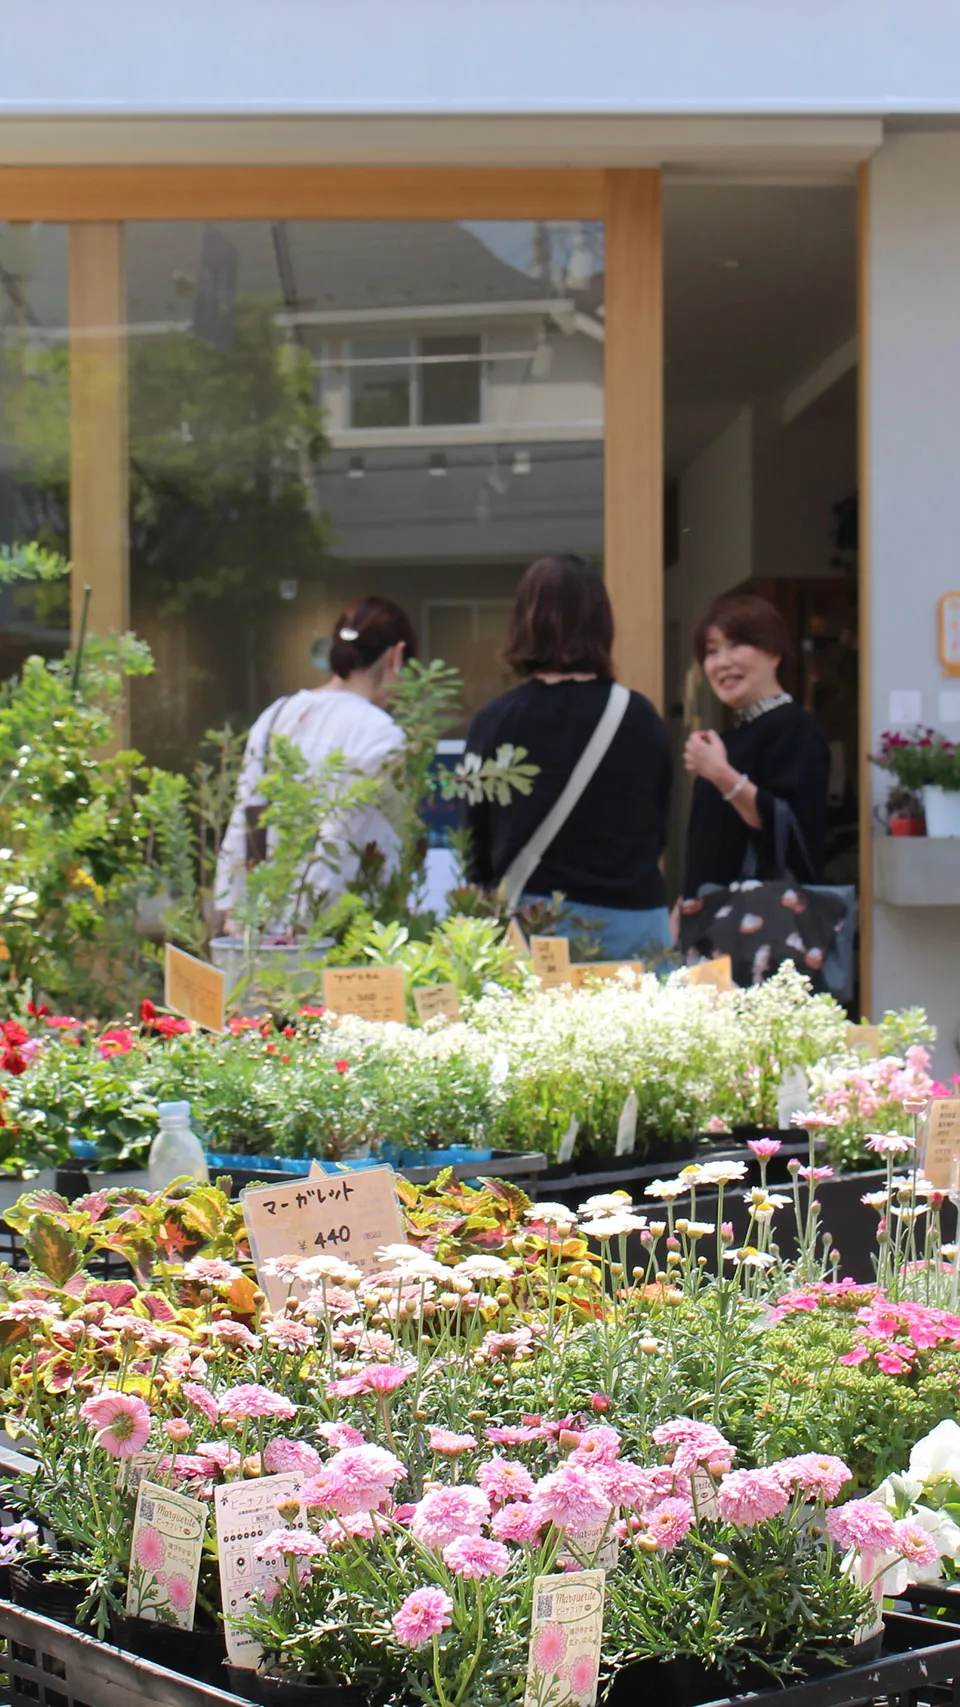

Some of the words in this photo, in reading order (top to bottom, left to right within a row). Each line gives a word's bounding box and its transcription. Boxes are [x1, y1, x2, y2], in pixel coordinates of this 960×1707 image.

[263, 1181, 354, 1215] マーガレット
[314, 1225, 350, 1249] 440
